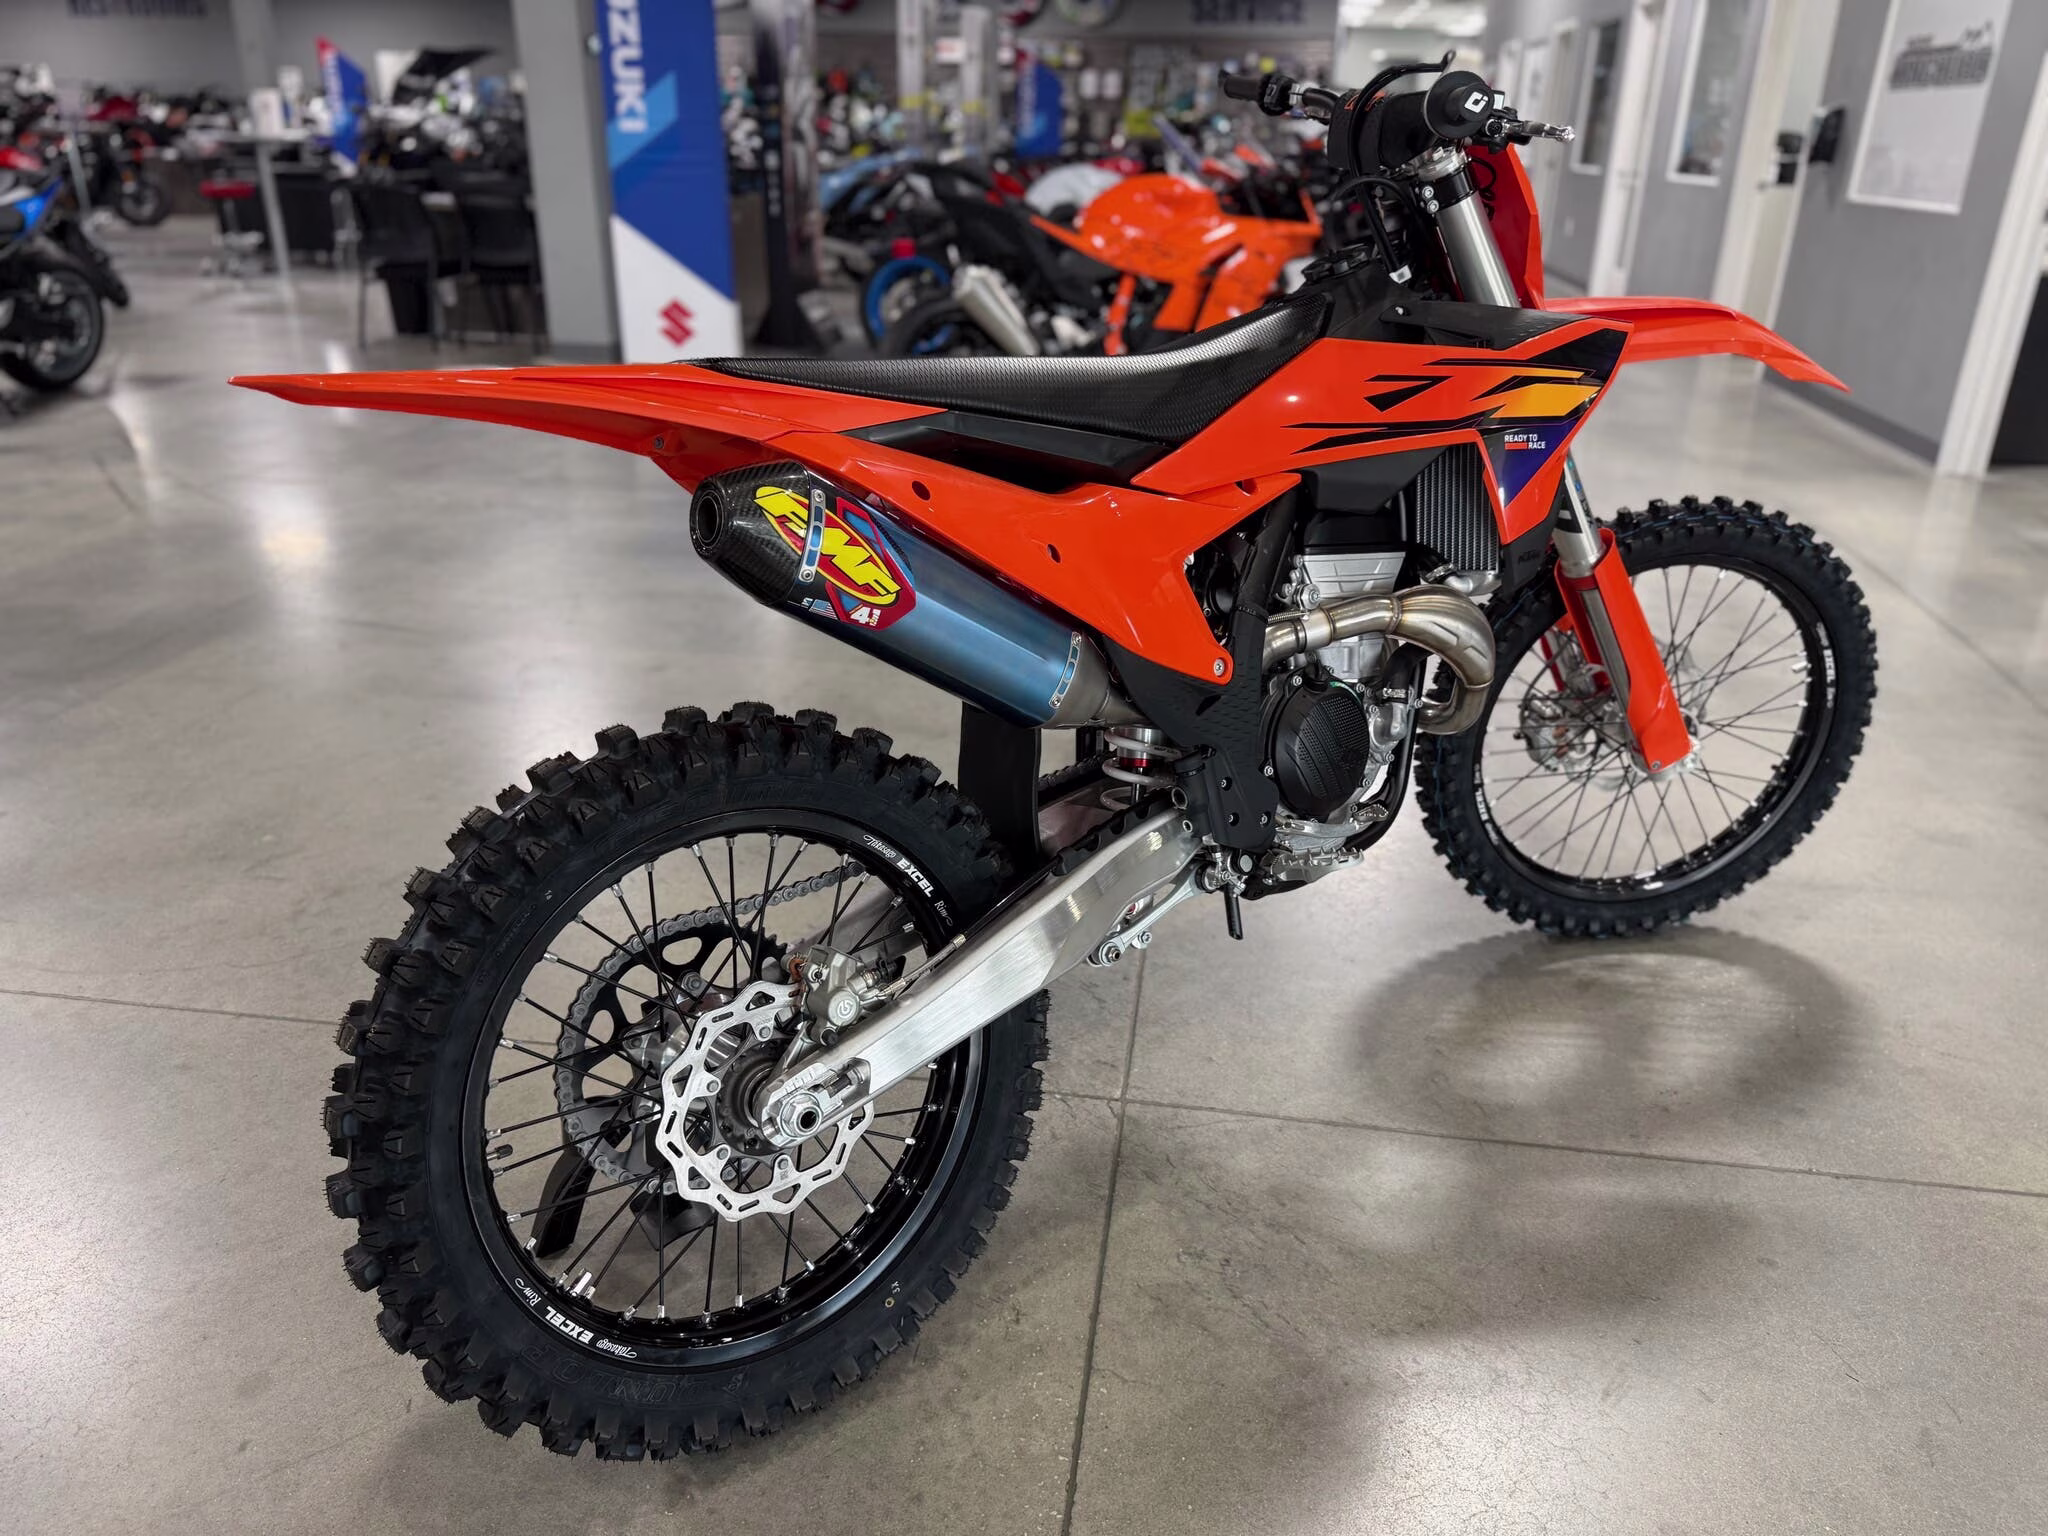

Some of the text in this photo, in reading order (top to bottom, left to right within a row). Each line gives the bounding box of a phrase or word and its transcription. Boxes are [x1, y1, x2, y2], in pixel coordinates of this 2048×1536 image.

[607, 0, 648, 133] ZUKI
[1504, 434, 1527, 442] READY
[1528, 441, 1546, 449] RACE
[896, 857, 934, 897] EXCEL
[934, 900, 953, 926] Rim
[515, 1277, 541, 1306] Rim
[545, 1305, 594, 1344] EXCEL
